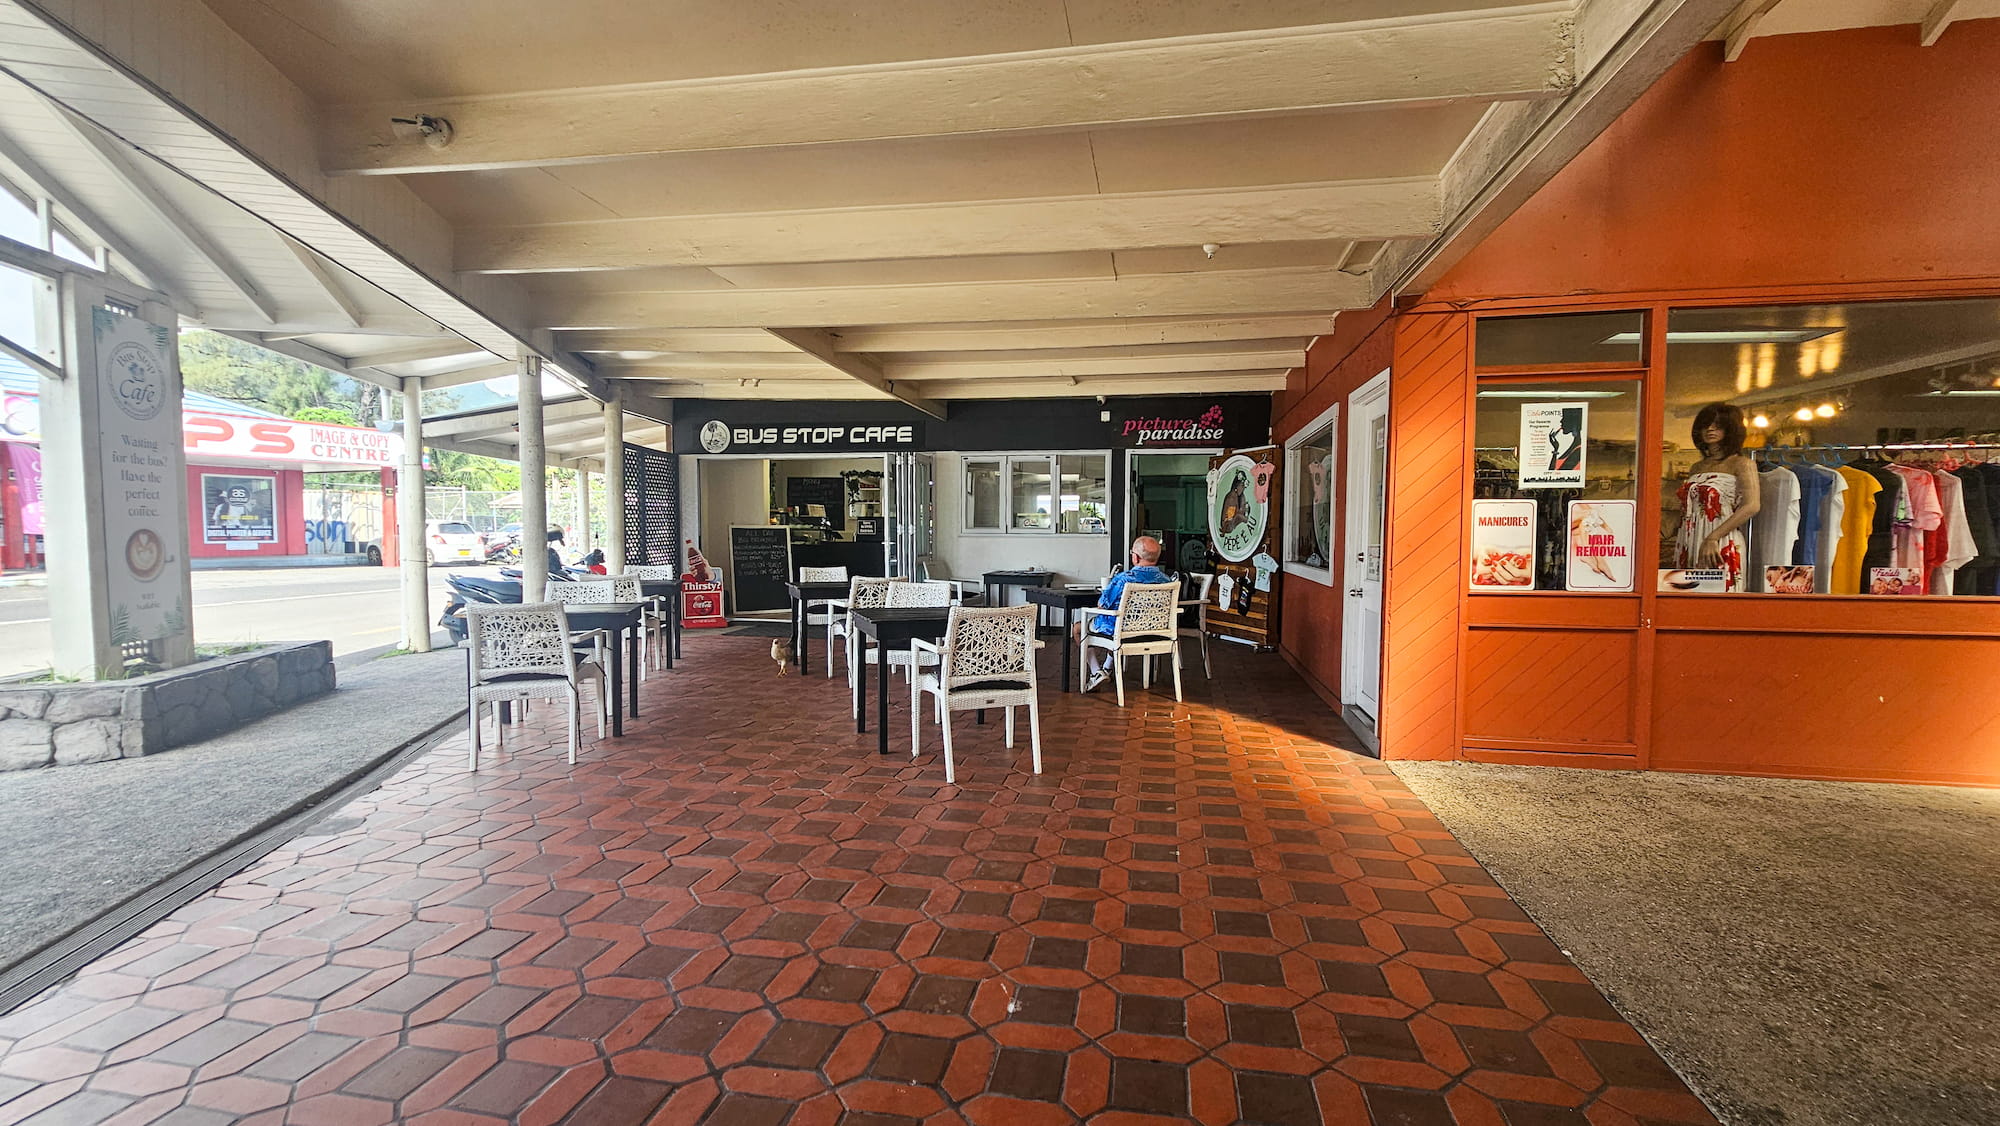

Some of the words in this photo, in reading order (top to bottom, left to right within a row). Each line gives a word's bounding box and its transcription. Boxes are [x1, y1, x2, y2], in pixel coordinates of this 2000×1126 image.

[1121, 416, 1194, 436] picture
[1135, 423, 1225, 446] paradise
[120, 434, 159, 452] Waiting
[310, 428, 347, 445] IMAGE
[350, 432, 360, 446] &
[362, 433, 390, 449] COPY
[733, 428, 778, 444] BUS
[783, 427, 845, 444] STOP
[849, 426, 913, 443] CAFE
[112, 450, 128, 463] for
[130, 453, 146, 465] the
[147, 455, 168, 467] bus?
[311, 444, 391, 462] CENTRE
[121, 469, 146, 482] Have
[147, 472, 162, 484] the
[125, 488, 160, 502] perfect
[1478, 516, 1529, 527] MANICURES
[1588, 535, 1615, 546] HAIR
[1576, 546, 1627, 557] REMOVAL
[682, 581, 722, 592] Thirsty?
